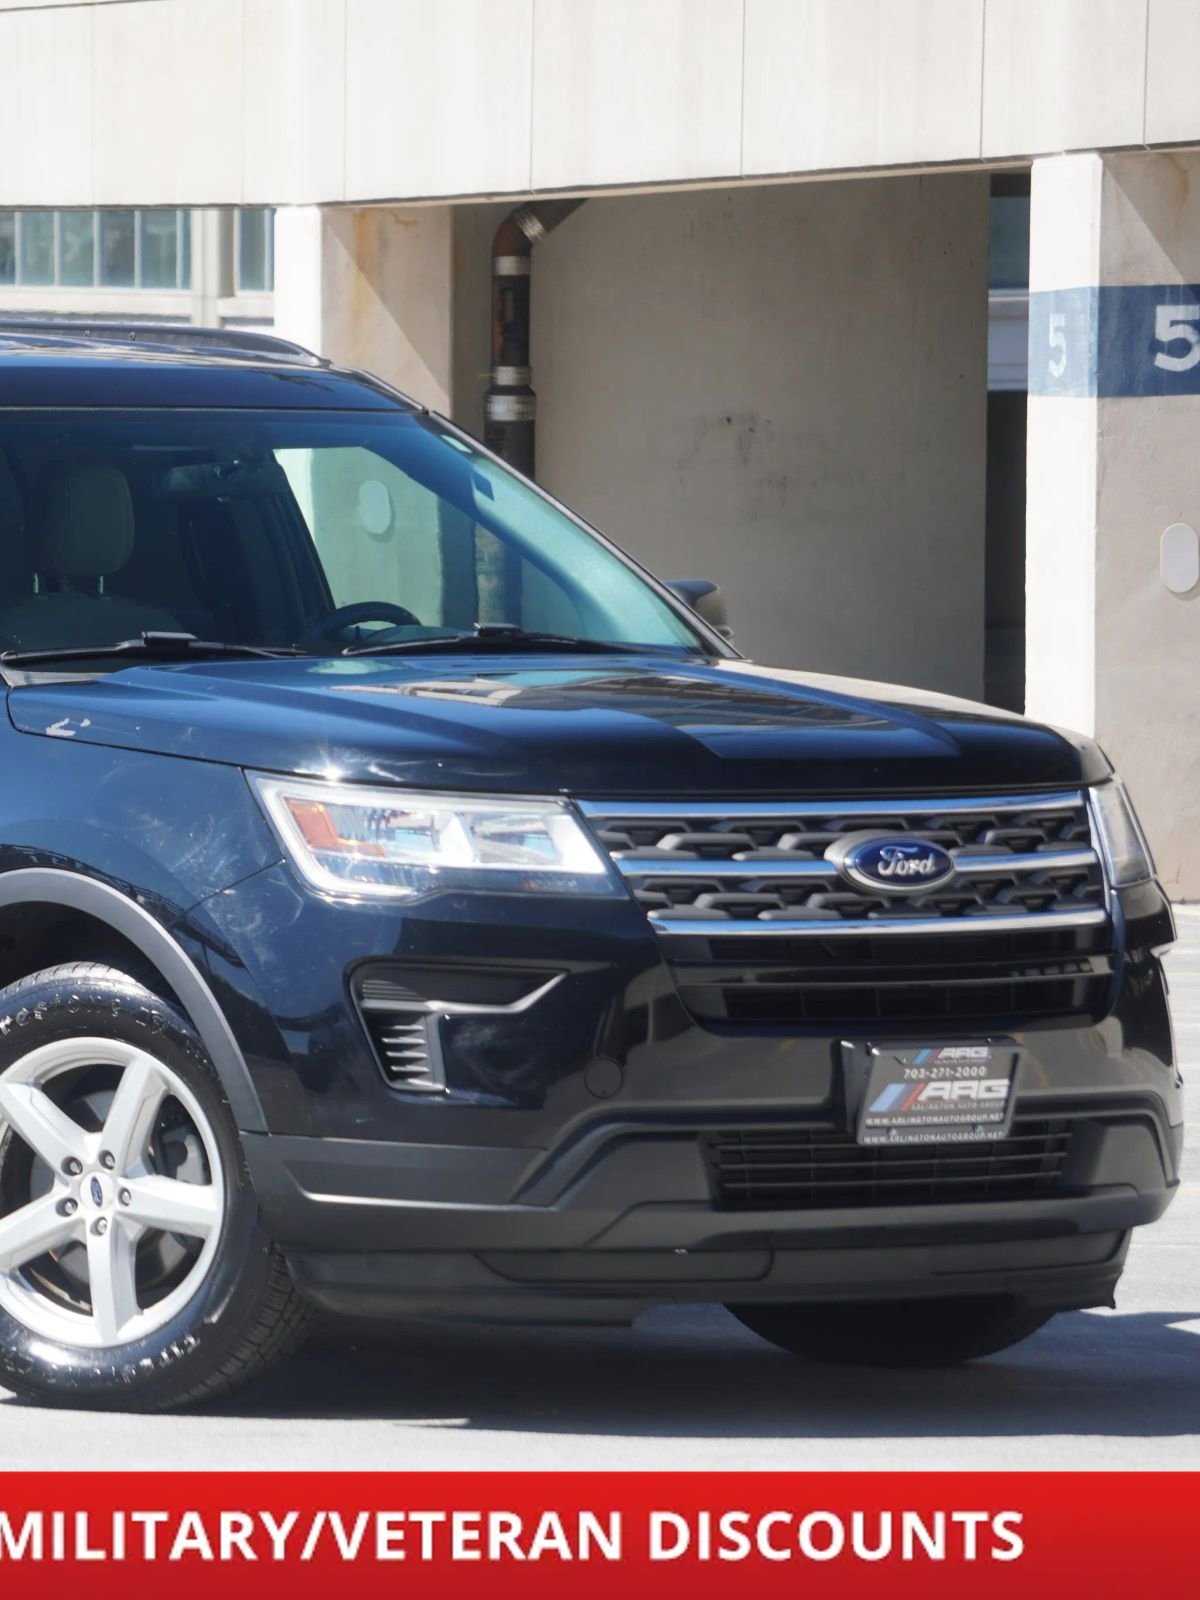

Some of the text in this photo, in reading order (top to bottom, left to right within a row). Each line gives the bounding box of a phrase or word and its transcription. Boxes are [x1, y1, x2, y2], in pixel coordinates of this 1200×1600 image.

[1154, 304, 1200, 372] 5
[1048, 313, 1067, 378] 5
[877, 845, 937, 877] Ford
[937, 1046, 989, 1059] AAG
[903, 1066, 987, 1080] 703-271-2000
[917, 1078, 1010, 1101] AAG
[911, 1102, 955, 1111] ARLINGTON
[865, 1113, 1004, 1126] WWW.ARLINGTONAUTOGROUP.NET
[863, 1131, 1003, 1144] WWW.ARLINGTONAUTOGROUP.NET
